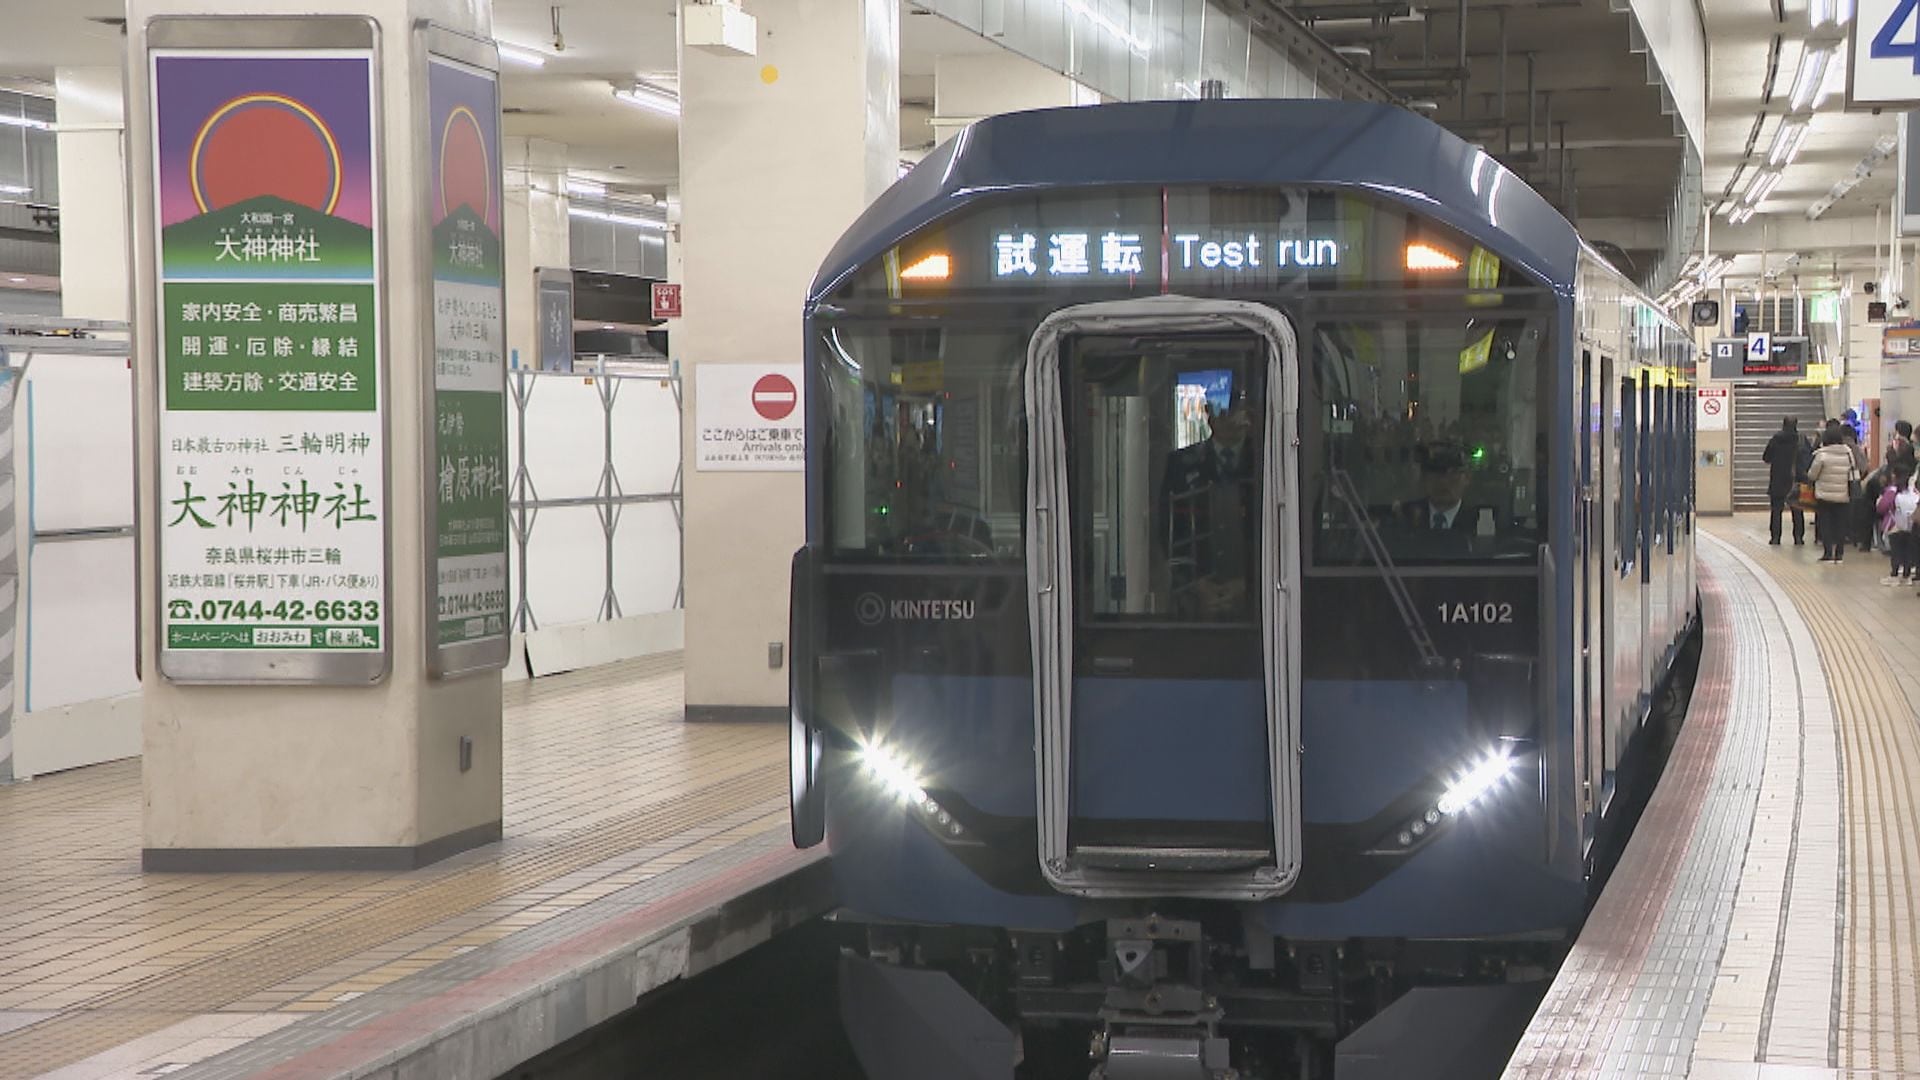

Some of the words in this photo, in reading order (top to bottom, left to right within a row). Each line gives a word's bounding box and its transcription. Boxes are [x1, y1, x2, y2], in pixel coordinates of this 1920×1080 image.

[1870, 0, 1920, 75] 4
[214, 234, 321, 262] 大神神社
[994, 232, 1142, 275] 試運転
[1174, 233, 1260, 268] Test
[1277, 239, 1338, 268] run
[656, 288, 674, 296] SOS
[1720, 345, 1729, 355] 4
[1751, 337, 1766, 355] 4
[171, 437, 269, 454] 日本最古の神社
[275, 431, 371, 456] 三輪明神
[742, 441, 782, 452] Arrivals
[167, 478, 378, 533] 大神神社
[205, 547, 342, 565] 奈良県桜井市三輪
[890, 599, 975, 620] KINTETSU
[1438, 602, 1513, 623] 1A102
[255, 630, 306, 644] おおみわ
